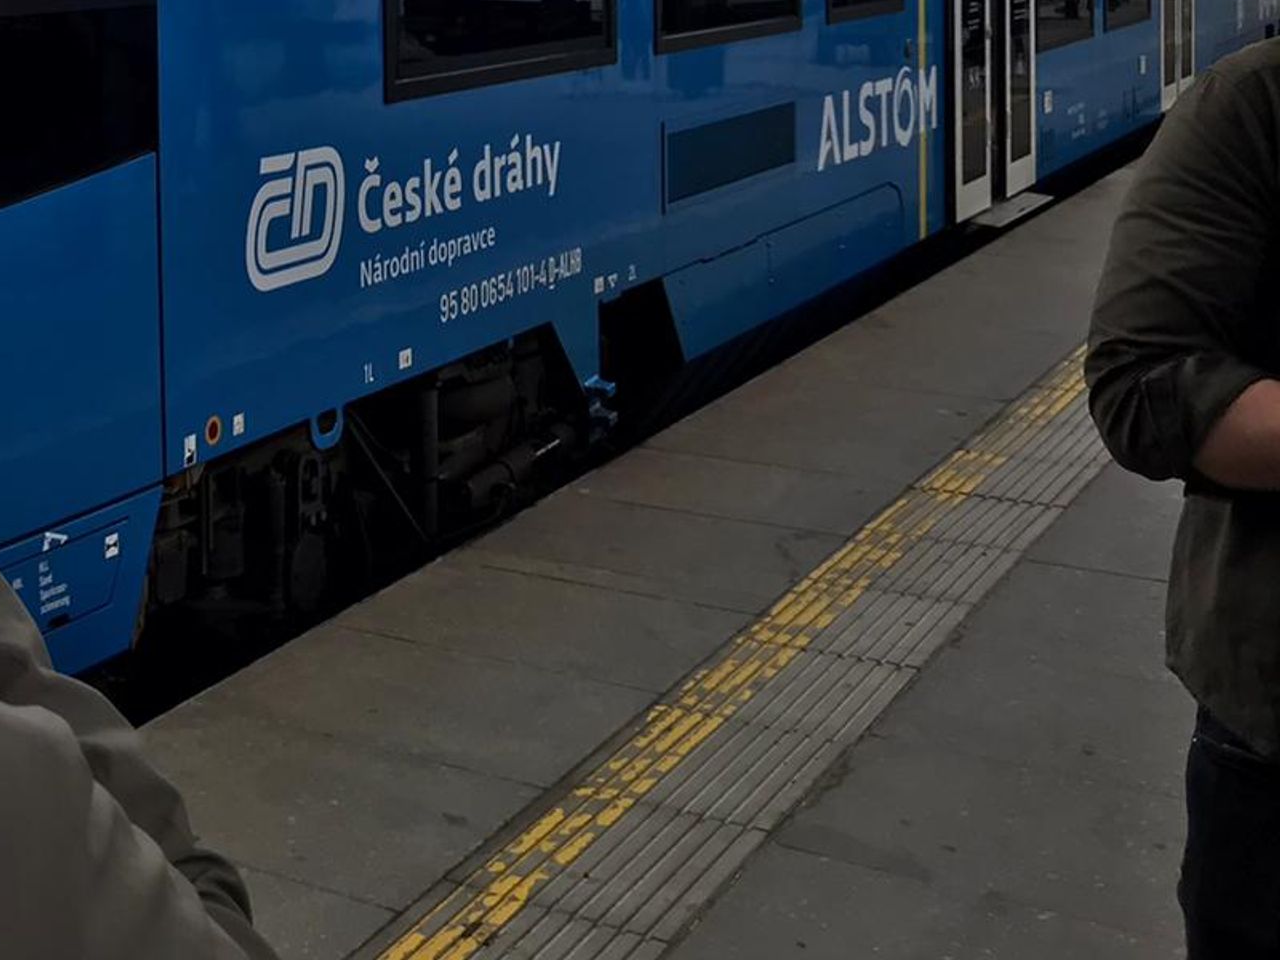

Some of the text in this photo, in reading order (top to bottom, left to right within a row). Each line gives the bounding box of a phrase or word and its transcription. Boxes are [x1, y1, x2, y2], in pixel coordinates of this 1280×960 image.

[817, 65, 938, 172] ALSTOM
[357, 134, 561, 234] České dráhy
[360, 226, 496, 289] Národní dopravce
[439, 290, 459, 324] 95
[460, 283, 479, 316] 80
[480, 270, 514, 308] 0654
